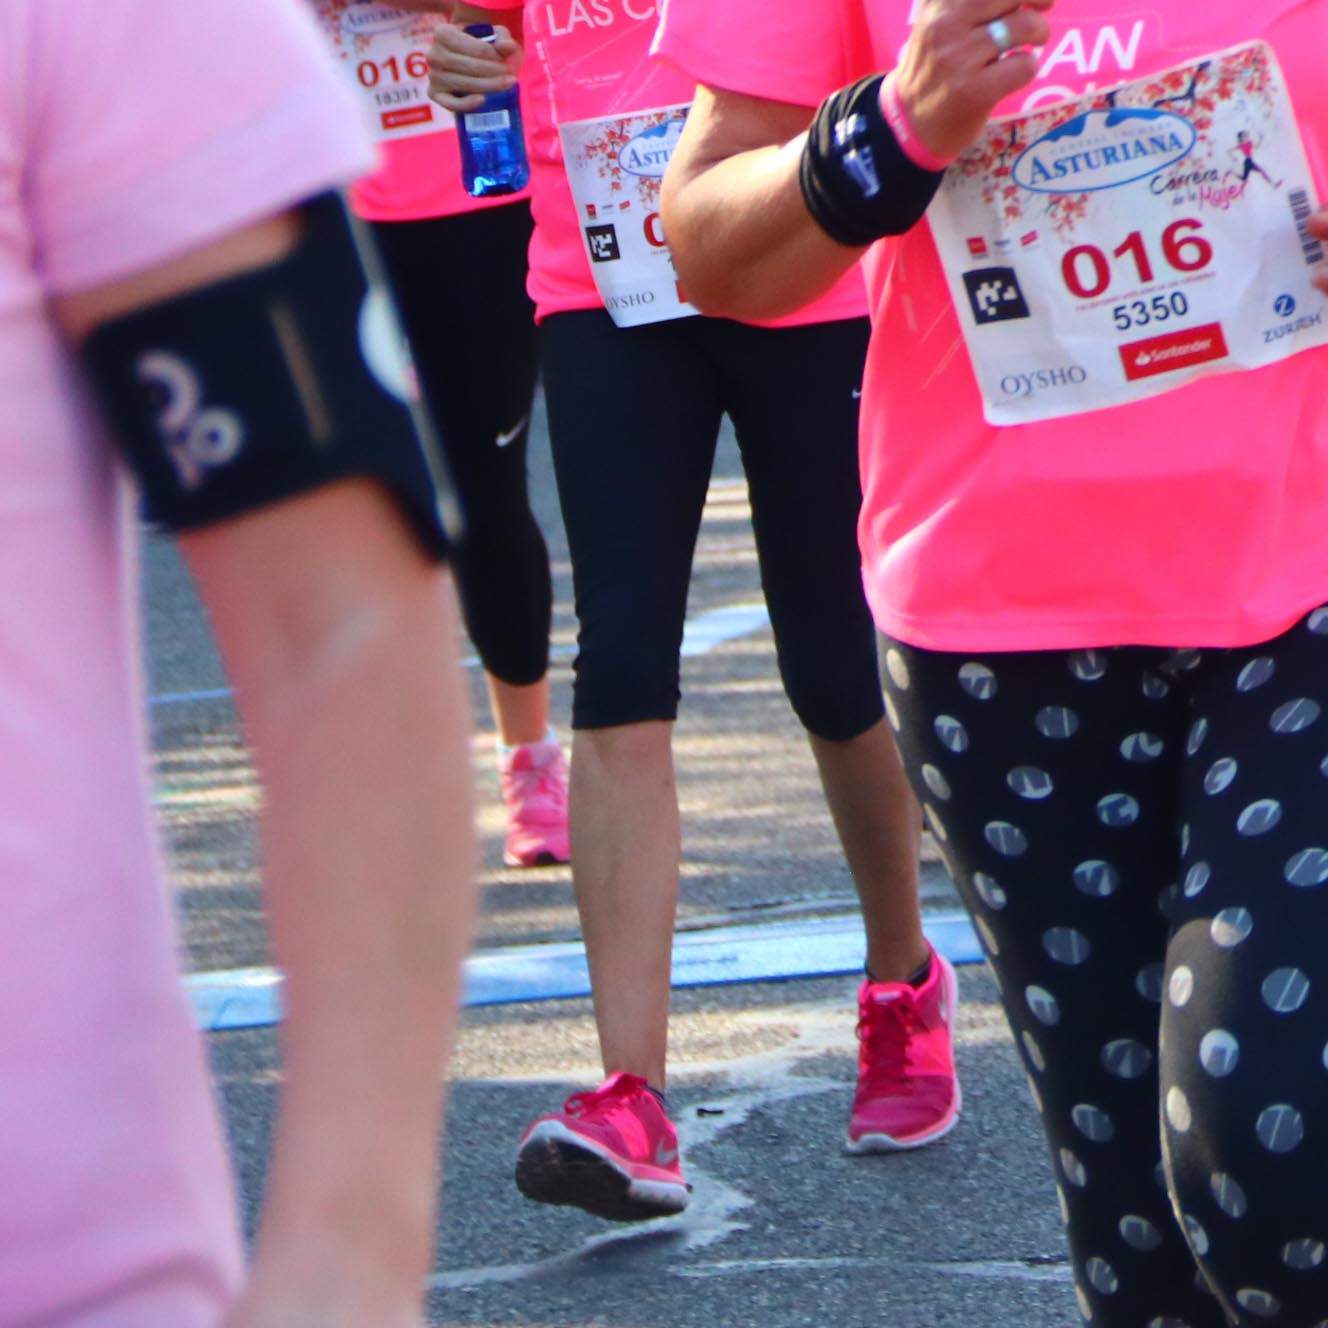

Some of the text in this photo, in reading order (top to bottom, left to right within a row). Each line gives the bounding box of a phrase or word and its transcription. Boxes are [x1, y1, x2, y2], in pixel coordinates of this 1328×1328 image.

[357, 51, 430, 89] 016
[1028, 131, 1185, 185] ASTURIANA
[1060, 217, 1214, 300] 016
[1111, 290, 1190, 332] 5350
[1000, 364, 1088, 398] OYSHO
